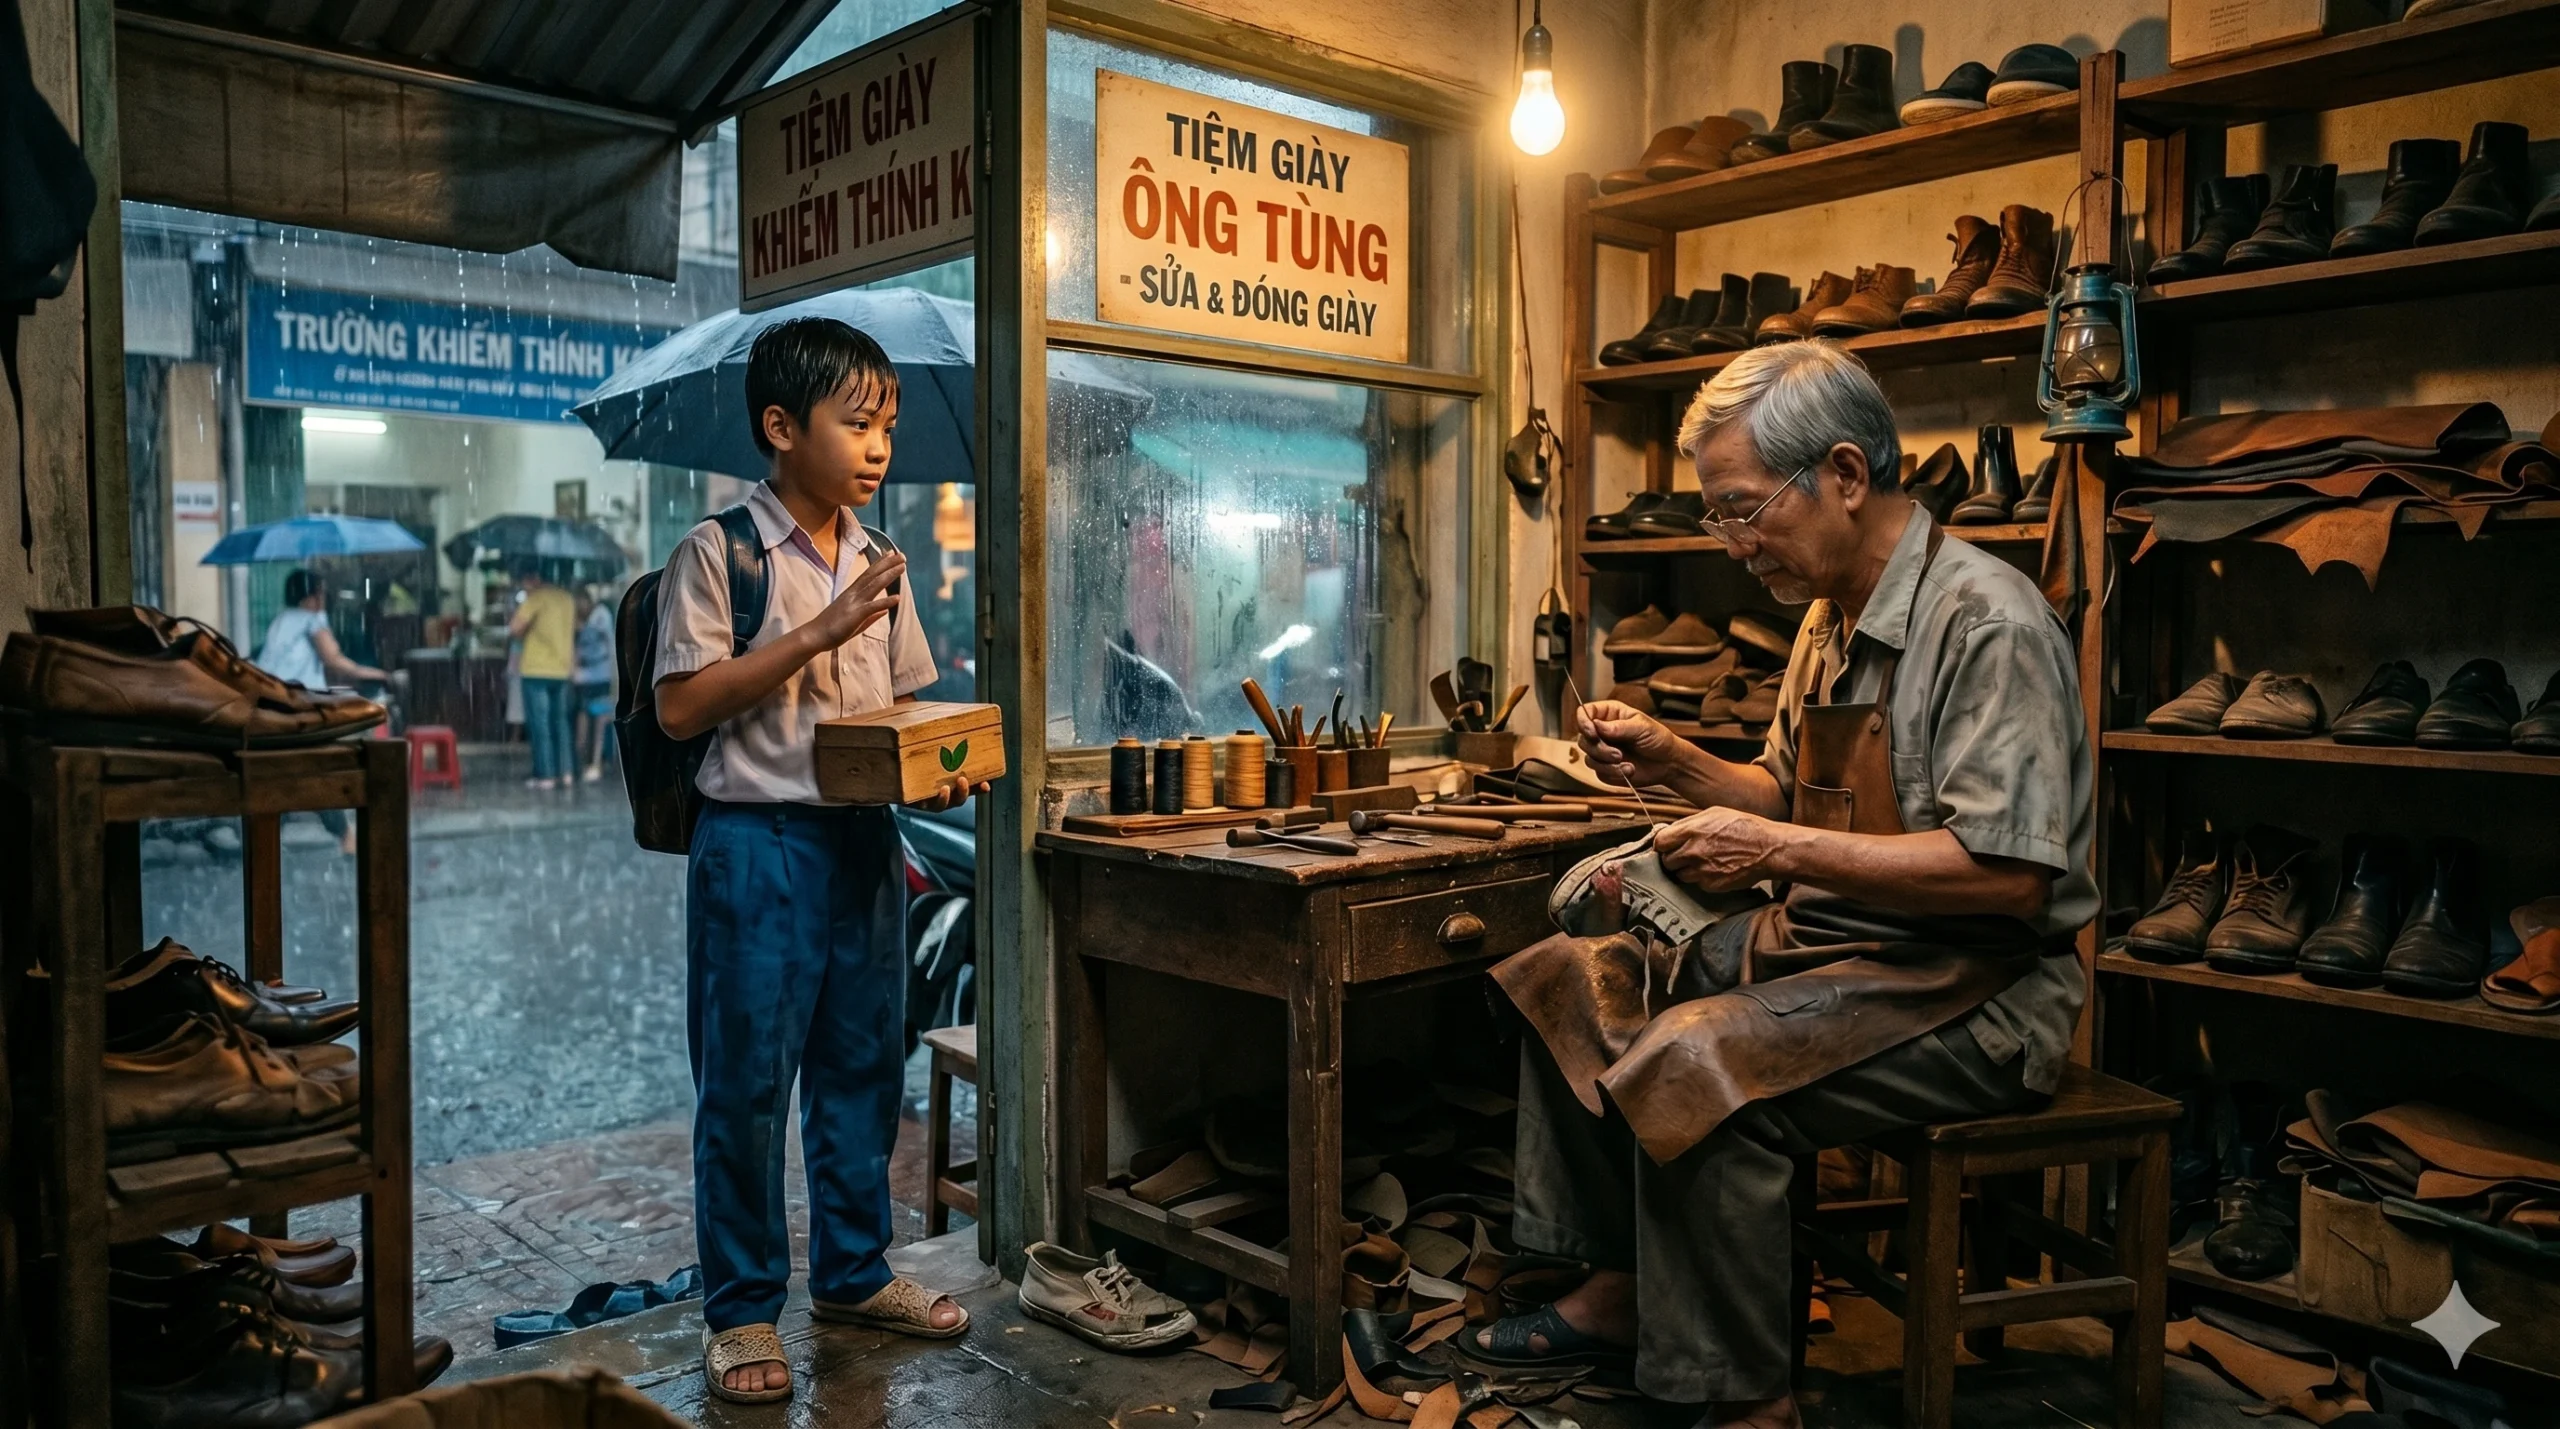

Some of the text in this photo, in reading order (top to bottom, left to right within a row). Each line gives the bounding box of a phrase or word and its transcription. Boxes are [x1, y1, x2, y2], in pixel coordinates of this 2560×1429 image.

[780, 52, 937, 180] TIỆM GIÀY
[1166, 110, 1351, 194] TIỆM GIÀY
[847, 149, 939, 249] THÍNH
[1122, 156, 1388, 285] ÔNG TÙNG
[1139, 253, 1200, 310] SỬA
[1207, 282, 1225, 315] &
[1232, 274, 1309, 328] ĐÓNG
[1317, 289, 1377, 337] GIÀY
[273, 307, 408, 361] TRƯỜNG
[519, 329, 604, 378] THÍNH
